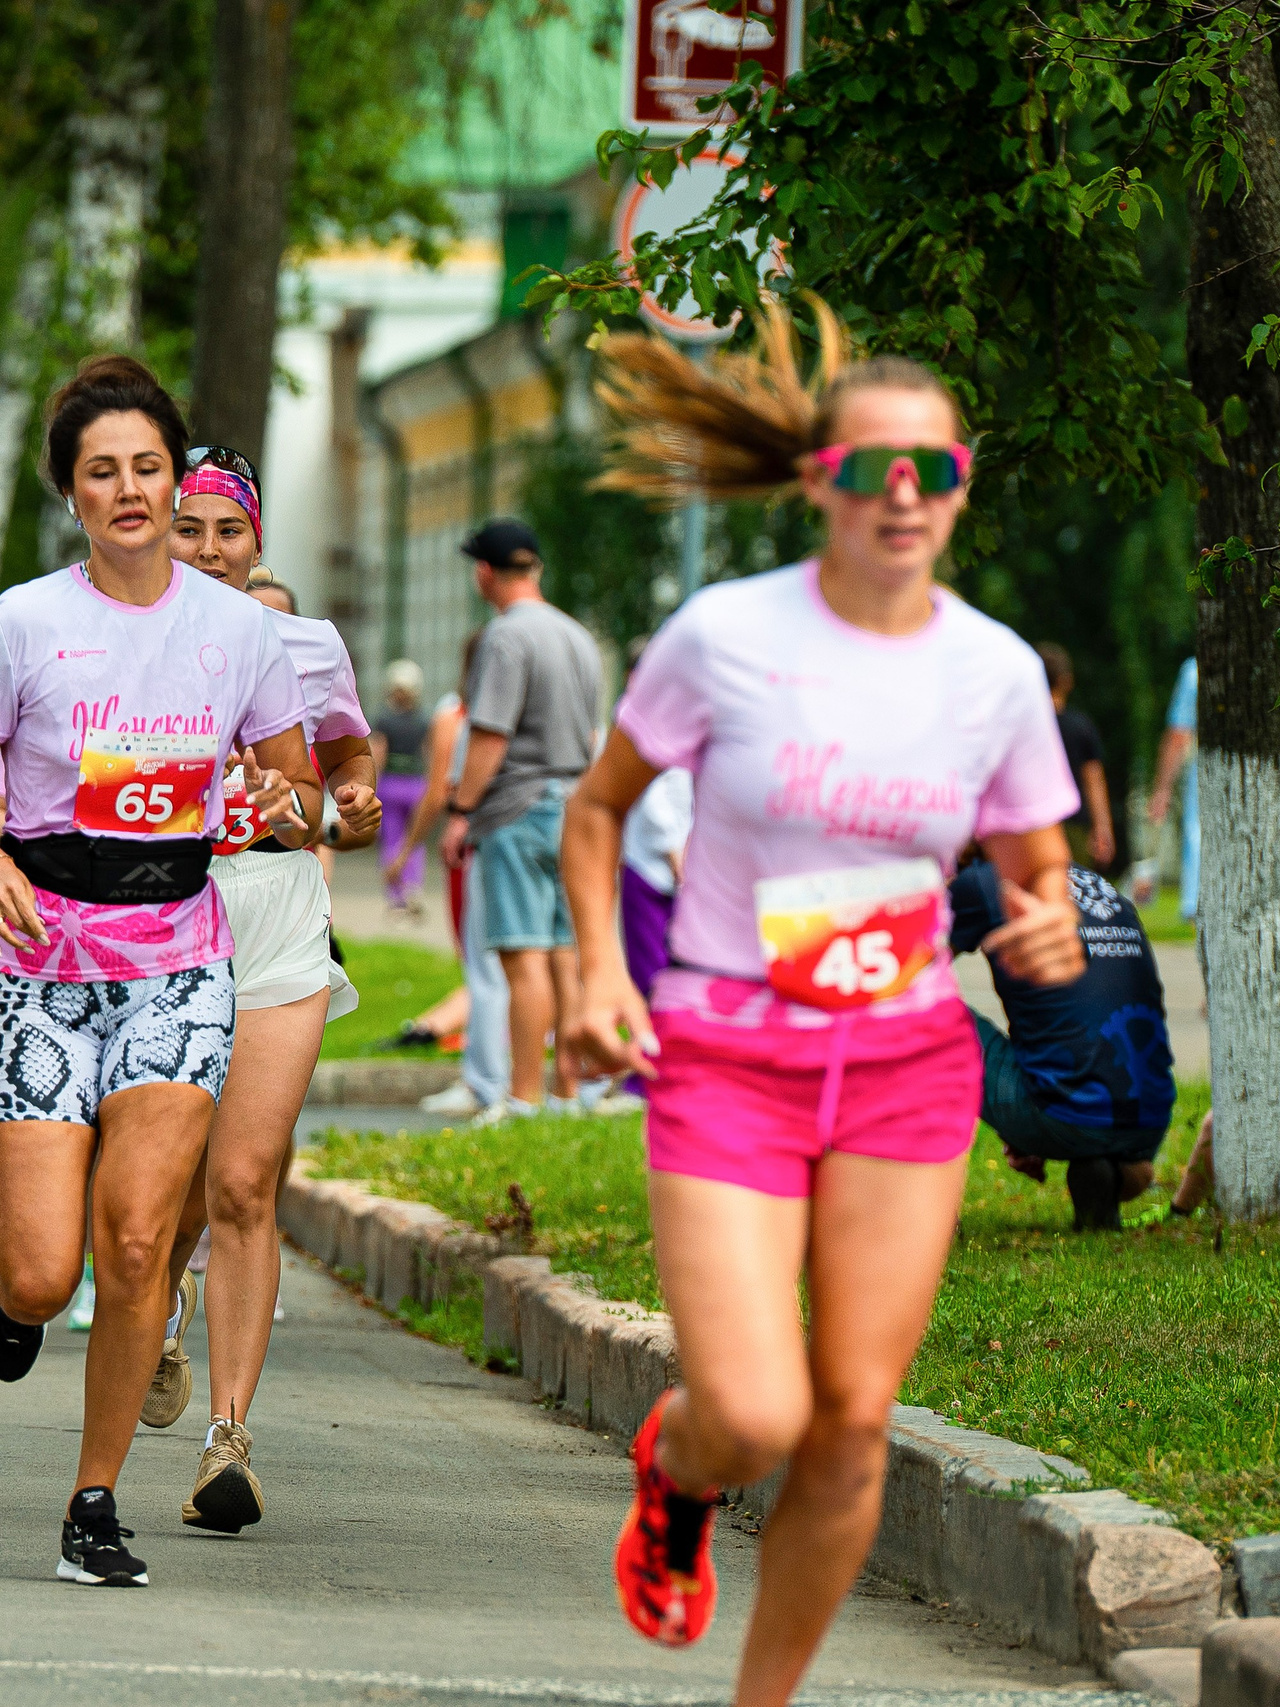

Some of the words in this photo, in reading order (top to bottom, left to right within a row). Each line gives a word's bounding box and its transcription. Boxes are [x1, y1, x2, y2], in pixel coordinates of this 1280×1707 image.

[115, 782, 174, 823] 65
[811, 929, 901, 996] 45
[1087, 942, 1142, 958] РОССИИ
